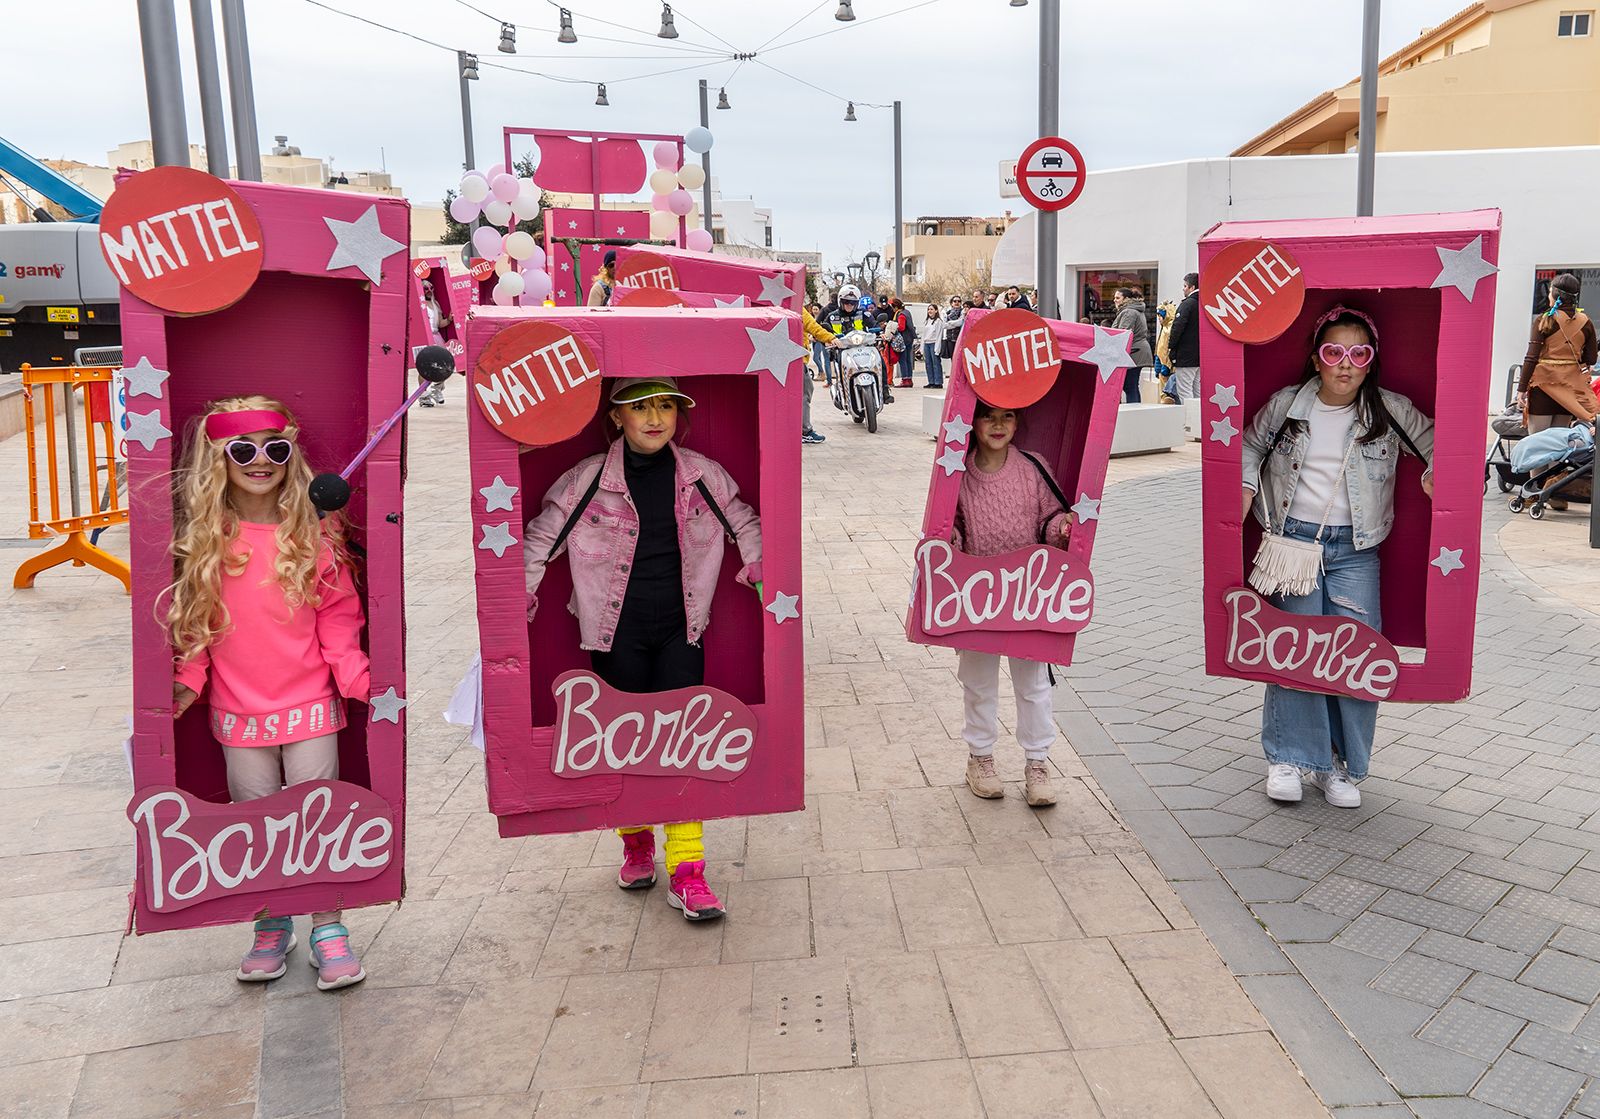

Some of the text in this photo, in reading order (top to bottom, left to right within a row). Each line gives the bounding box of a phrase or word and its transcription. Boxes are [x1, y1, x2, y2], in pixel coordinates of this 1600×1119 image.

[101, 197, 259, 285] MATTEL
[470, 261, 492, 277] MATTEL
[1204, 245, 1301, 334] MATTEL
[475, 335, 600, 426] MATTEL
[963, 326, 1062, 385] MATTEL
[916, 538, 1093, 630] Barbie
[1225, 590, 1399, 698] Barbie
[554, 675, 754, 774] Barbie
[133, 786, 393, 909] Barbie
